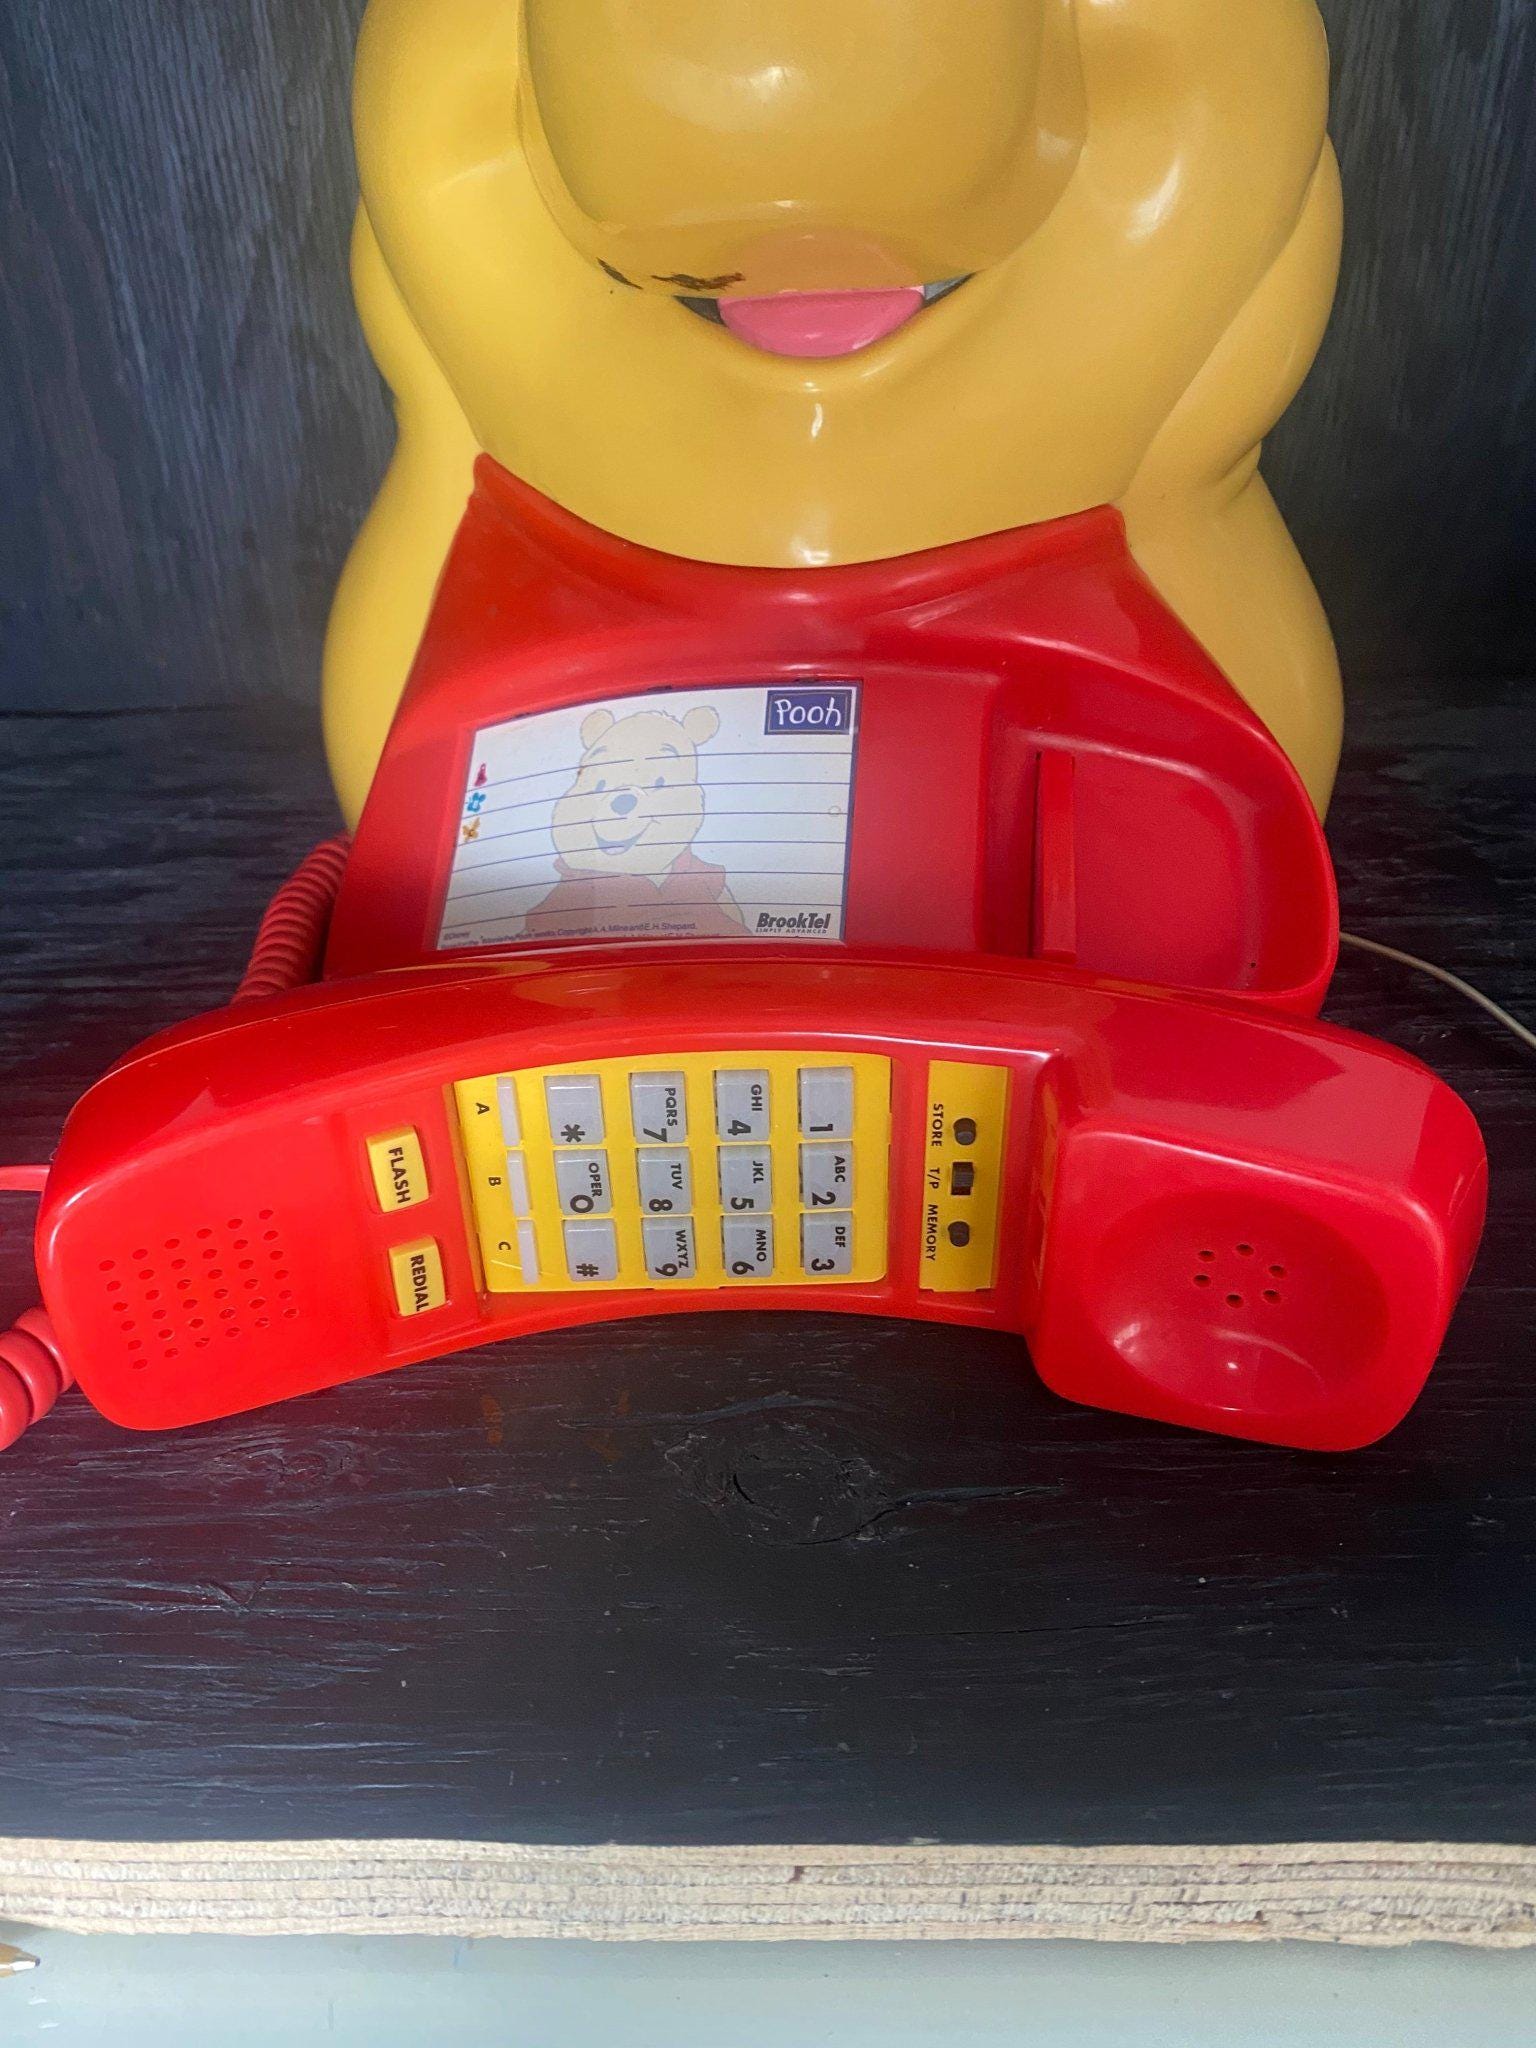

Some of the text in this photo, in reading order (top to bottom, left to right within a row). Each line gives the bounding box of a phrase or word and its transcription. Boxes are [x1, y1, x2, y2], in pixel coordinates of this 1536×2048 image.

[774, 698, 842, 728] Pooh
[756, 912, 831, 929] BrookTel
[476, 1102, 490, 1115] A
[664, 1087, 678, 1127] PQRS
[751, 1084, 763, 1112] GHI
[643, 1128, 668, 1143] 7
[728, 1120, 751, 1136] 4
[809, 1124, 834, 1132] 1
[931, 1103, 944, 1147] STORE
[388, 1146, 411, 1204] FLASH
[588, 1162, 603, 1198] OPER
[670, 1163, 683, 1190] TUV
[752, 1160, 764, 1184] JKL
[834, 1155, 846, 1183] ABC
[926, 1166, 941, 1189] T/P
[488, 1176, 502, 1187] B
[649, 1199, 673, 1212] 8
[730, 1197, 754, 1210] 5
[811, 1191, 836, 1206] 2
[835, 1226, 846, 1248] DEF
[925, 1204, 938, 1261] MEMORY
[498, 1241, 511, 1251] C
[675, 1229, 689, 1269] WXYZ
[756, 1229, 767, 1262] MNO
[655, 1263, 678, 1277] 9
[732, 1261, 755, 1275] 6
[811, 1258, 835, 1272] 3
[410, 1254, 429, 1311] REDIAL
